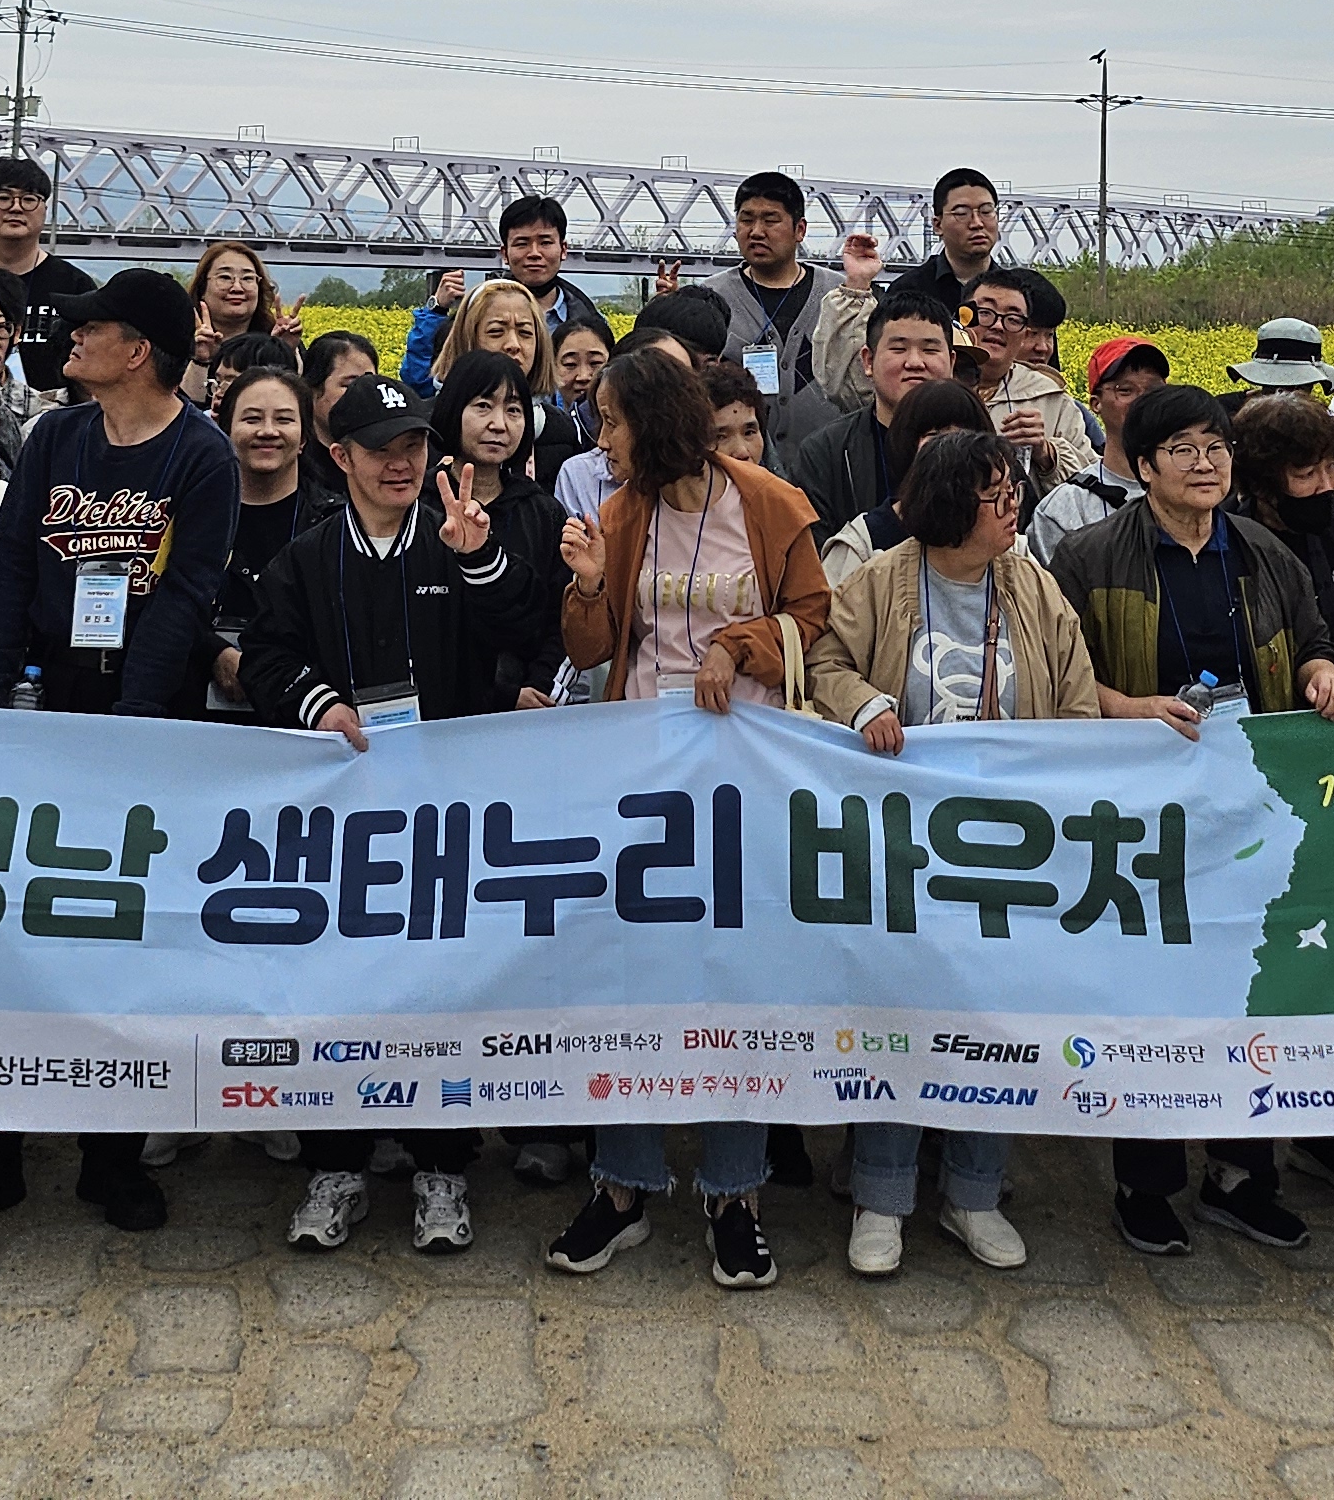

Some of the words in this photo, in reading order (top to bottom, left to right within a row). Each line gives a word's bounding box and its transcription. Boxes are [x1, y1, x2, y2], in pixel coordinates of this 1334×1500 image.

[376, 383, 408, 409] LA
[41, 484, 172, 530] Dickies
[67, 534, 148, 553] ORIGINAL
[197, 783, 743, 946] 생태누리
[788, 788, 1193, 946] 바우처
[312, 1040, 382, 1063] KOEN
[385, 1040, 463, 1058] 한국남동발전
[555, 1032, 663, 1054] 세아창원특수강
[683, 1028, 739, 1051] BNK
[741, 1029, 815, 1052] 경남은행
[861, 1030, 910, 1053] 농협
[930, 1032, 1041, 1064] SEBANG
[229, 1040, 293, 1065] 후원기관
[1100, 1043, 1206, 1064] 주택관리공단
[813, 1067, 868, 1079] HYUNDAI
[358, 1077, 419, 1106] KAI
[478, 1079, 565, 1102] 해성디에스
[617, 1073, 787, 1098] 동서식품주식회사
[834, 1078, 897, 1102] WIA
[919, 1081, 1039, 1107] DOOSAN
[280, 1090, 335, 1107] 복지재단
[1071, 1090, 1107, 1114] 캠코
[1123, 1091, 1223, 1109] 한국자산관리공사
